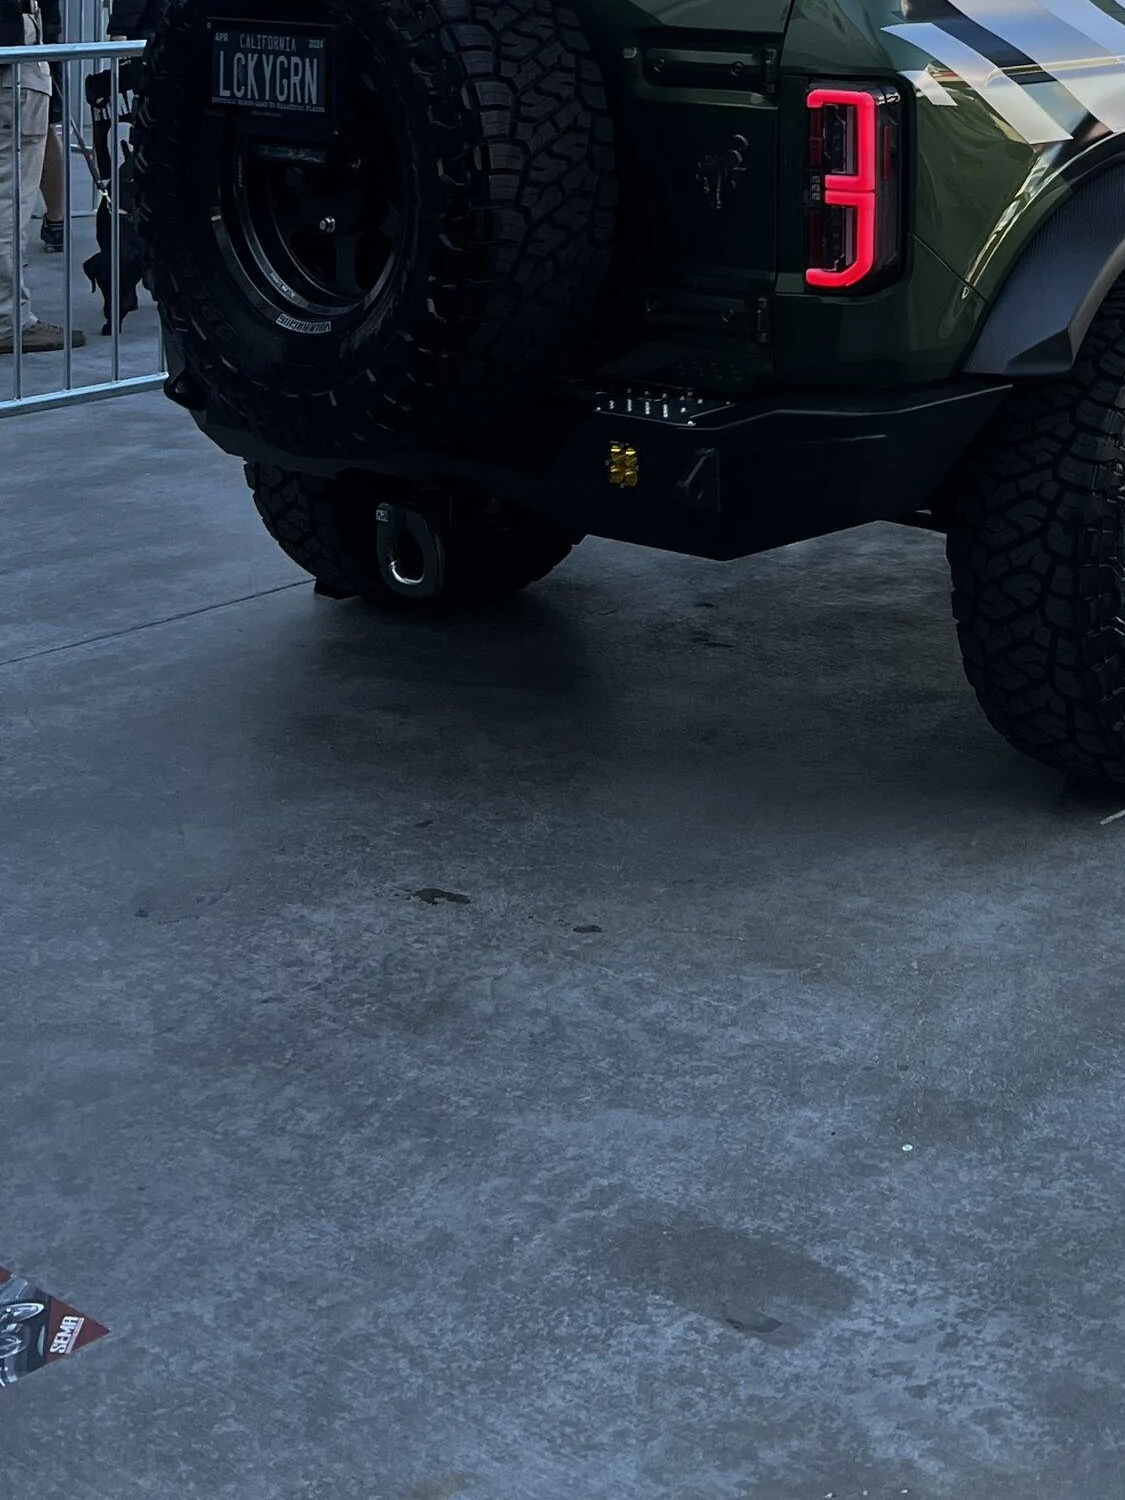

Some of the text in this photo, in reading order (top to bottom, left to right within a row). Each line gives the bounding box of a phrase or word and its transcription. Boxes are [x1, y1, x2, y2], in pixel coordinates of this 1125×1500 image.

[240, 34, 297, 52] CALIFORNIA
[219, 49, 319, 105] LCKYGRN
[50, 1315, 80, 1354] SEMA
